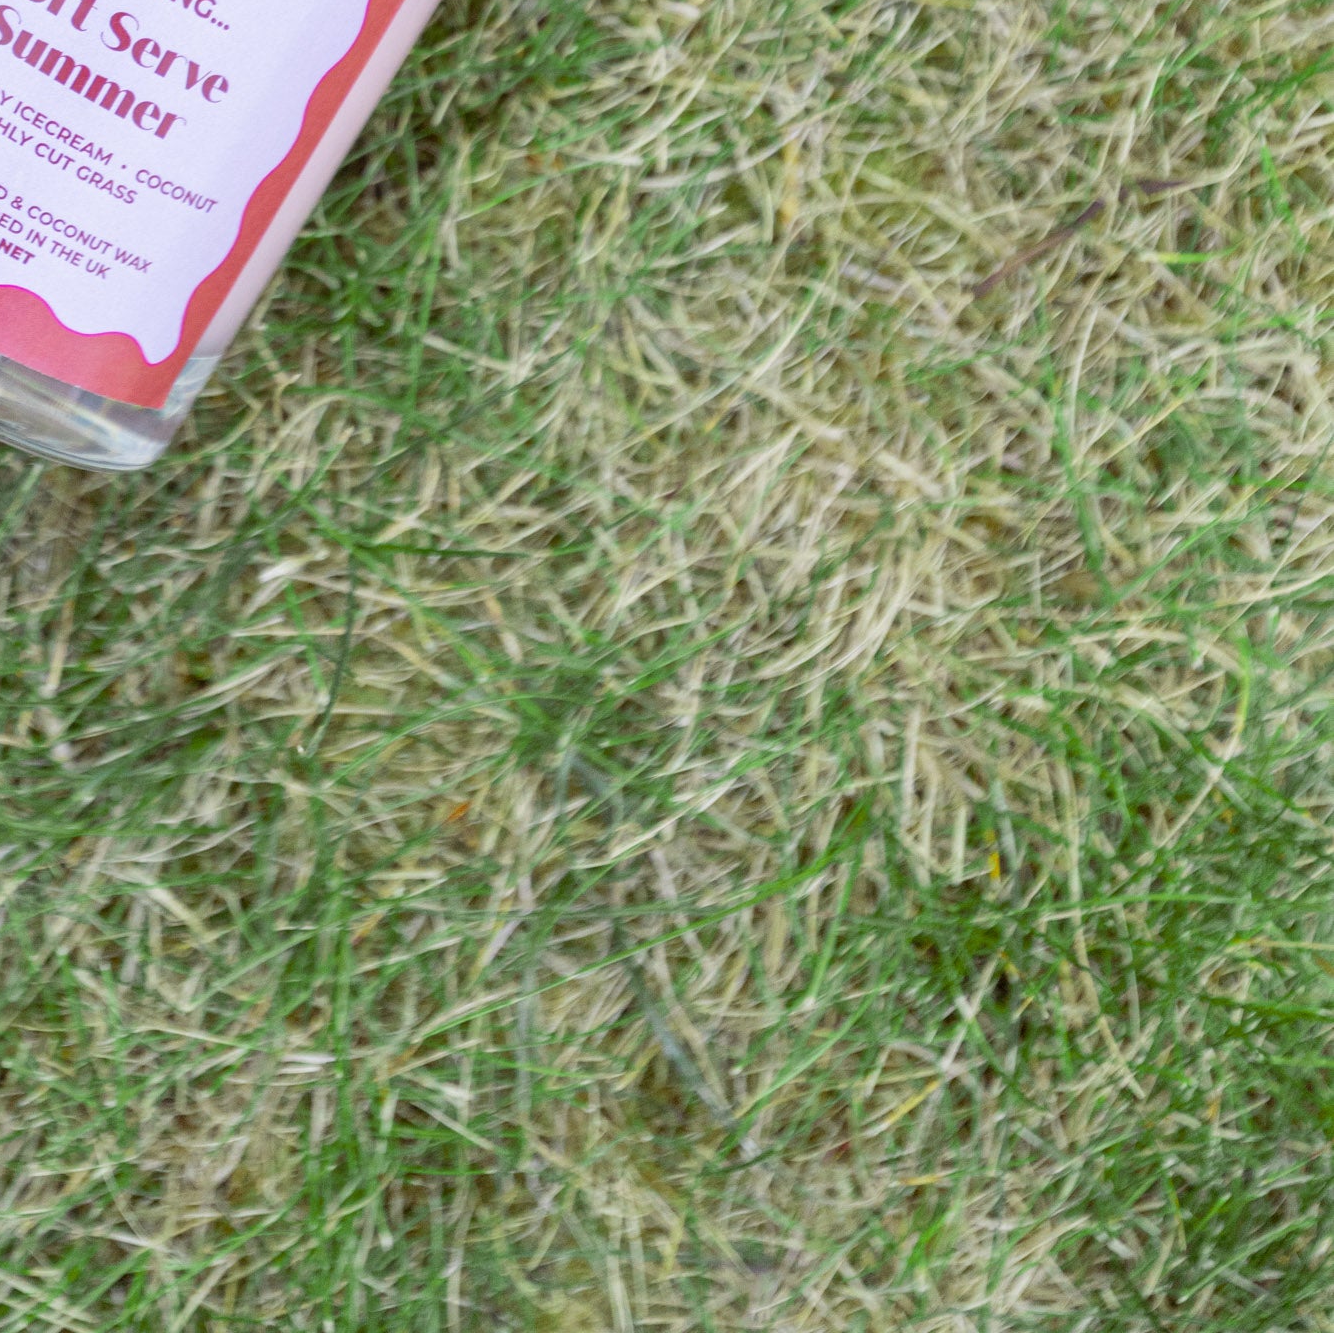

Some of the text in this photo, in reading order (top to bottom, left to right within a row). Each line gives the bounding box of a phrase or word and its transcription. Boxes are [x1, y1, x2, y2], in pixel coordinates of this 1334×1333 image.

[100, 11, 229, 103] Serve
[13, 101, 114, 166] ICECREAM
[136, 169, 218, 213] COCONUT
[34, 142, 75, 170] CUT
[76, 166, 138, 204] GRASS
[10, 196, 24, 210] &
[27, 206, 113, 254] COCONUT
[115, 248, 152, 273] WAX
[25, 229, 48, 247] IN
[50, 240, 84, 267] THE
[85, 259, 111, 279] UK
